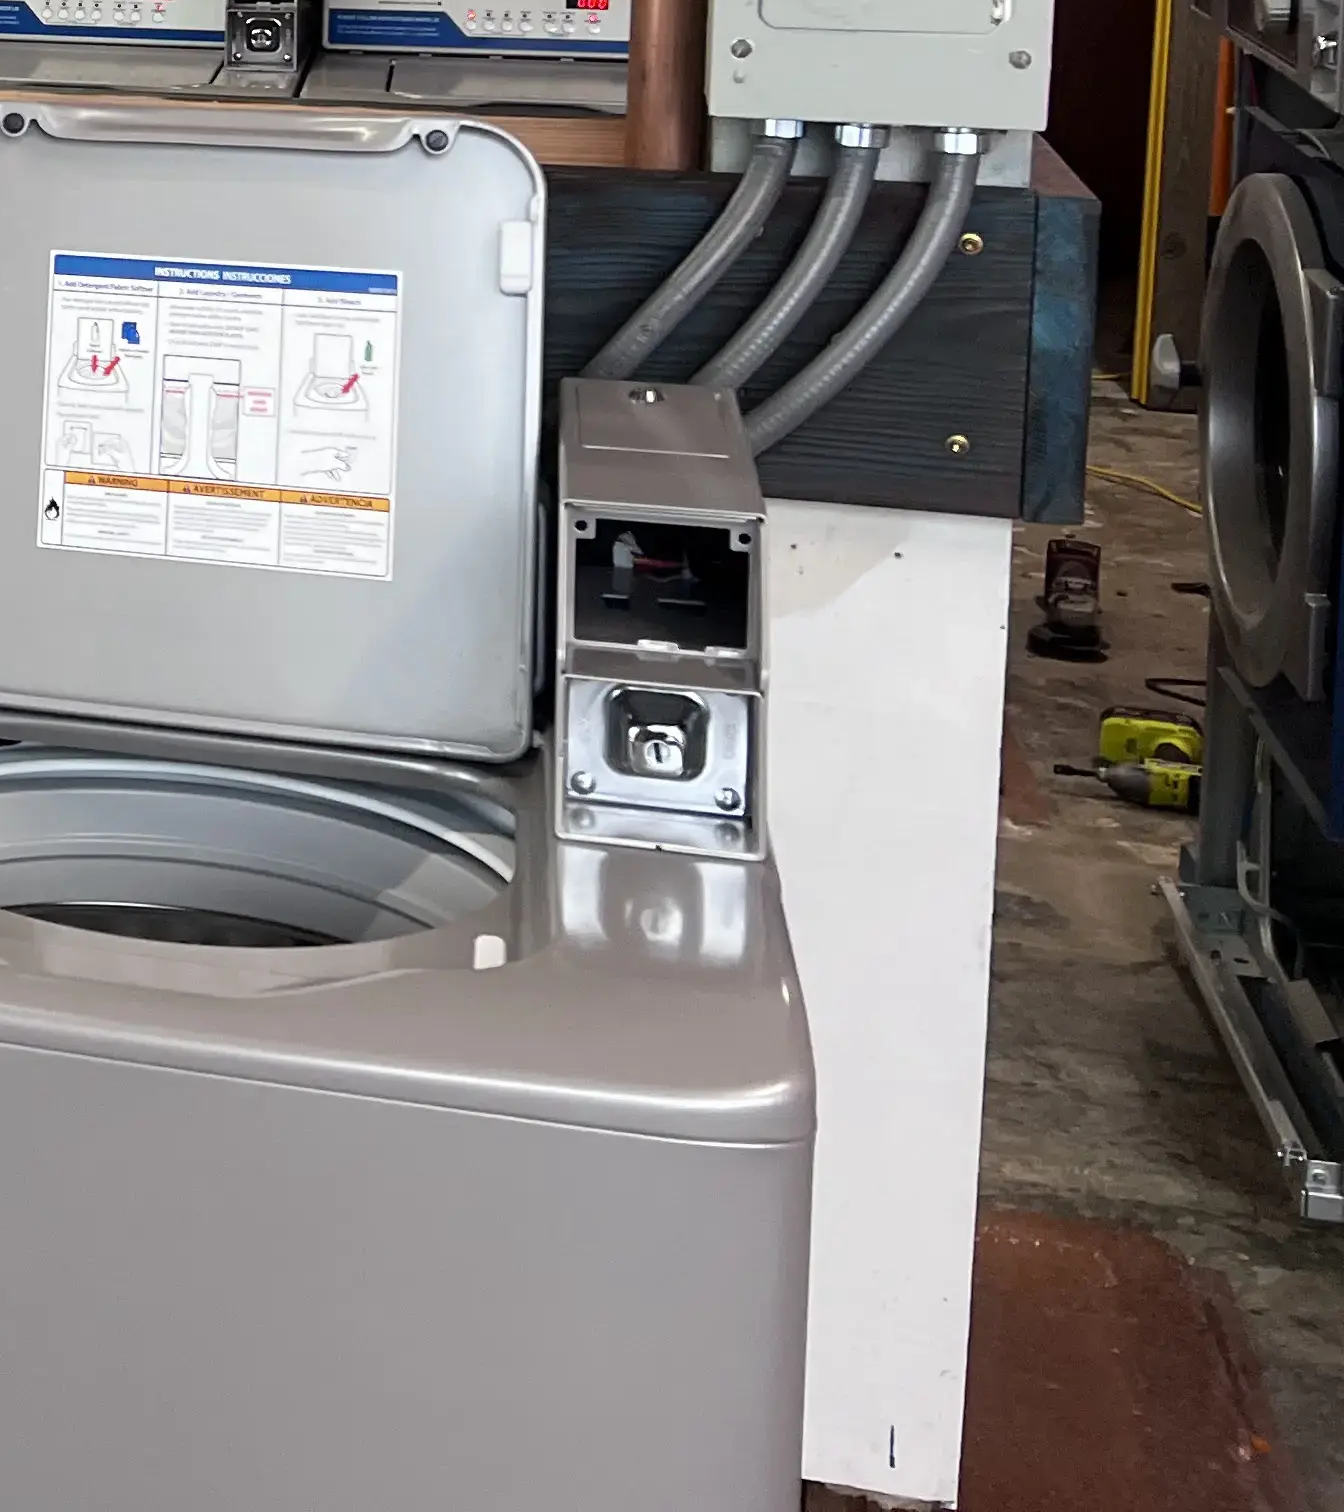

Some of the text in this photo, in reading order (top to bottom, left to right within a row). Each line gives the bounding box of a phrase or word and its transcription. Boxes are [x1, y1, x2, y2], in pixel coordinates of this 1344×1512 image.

[154, 266, 220, 279] INSTRUCTIONS
[97, 476, 373, 508] WARNING AVERTISSEMENT ADVERTENCIA
